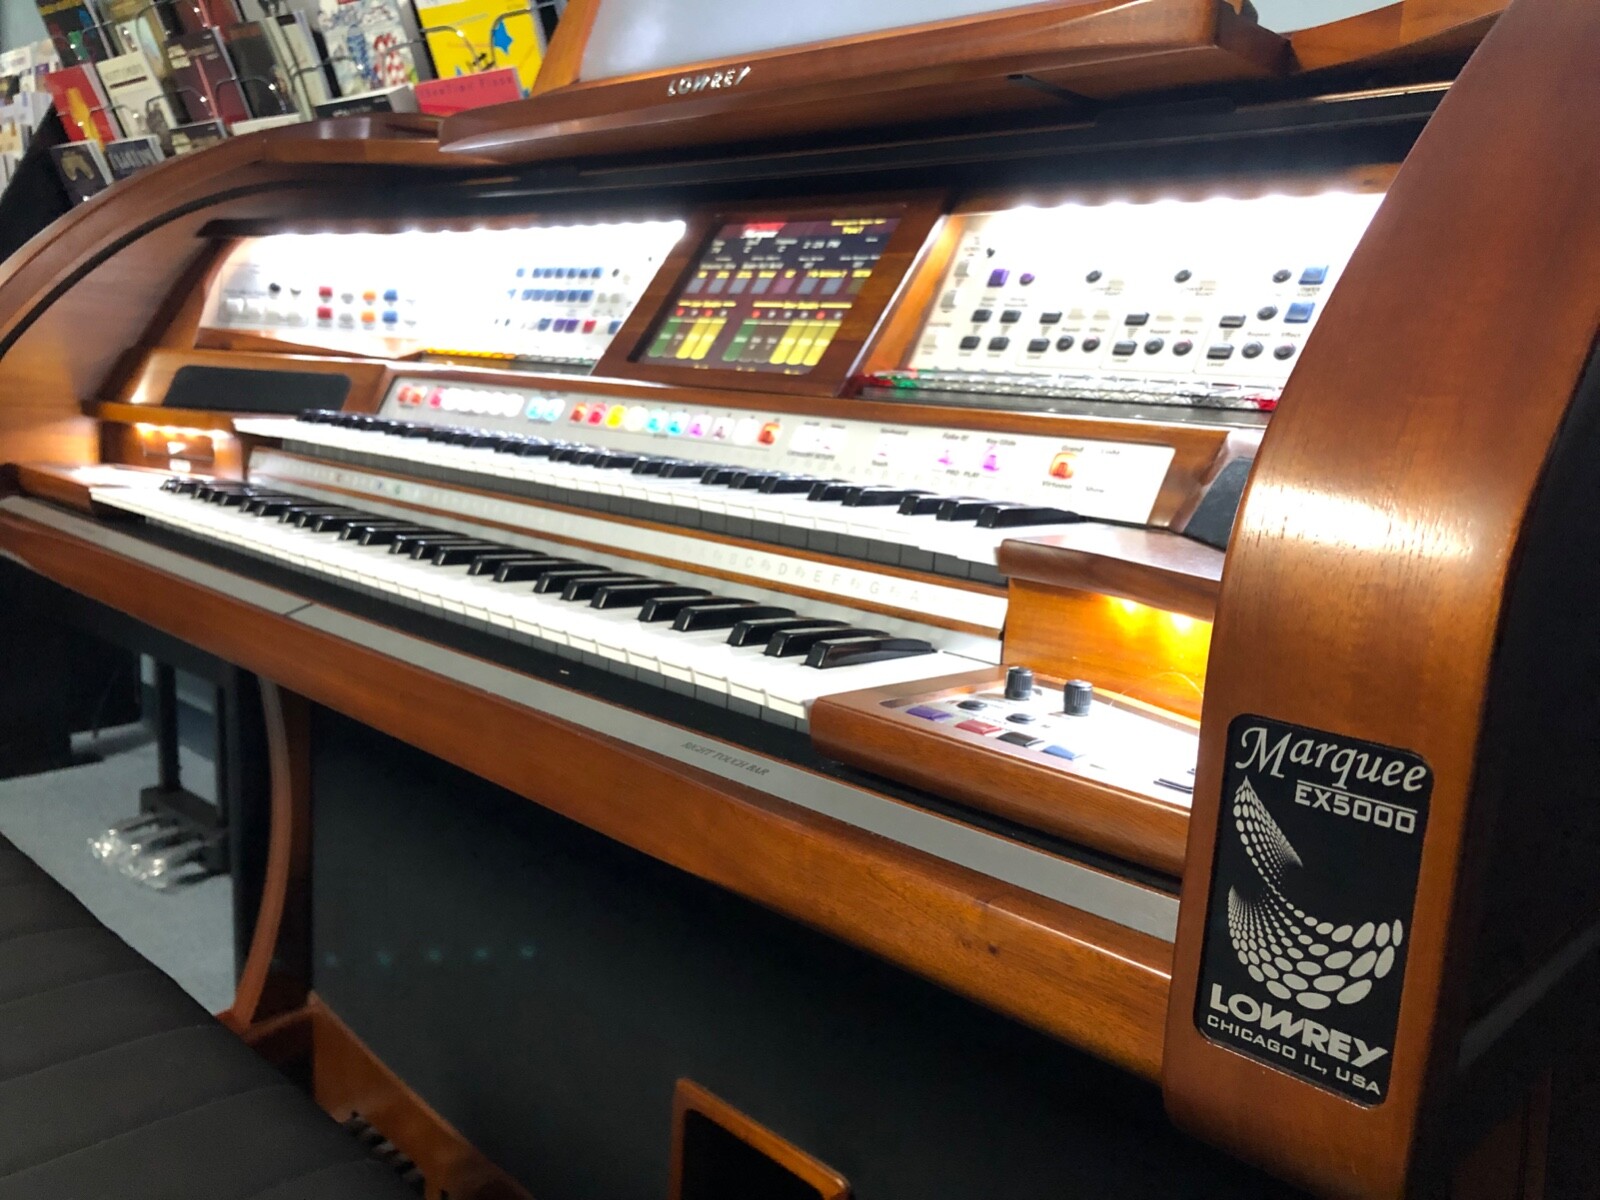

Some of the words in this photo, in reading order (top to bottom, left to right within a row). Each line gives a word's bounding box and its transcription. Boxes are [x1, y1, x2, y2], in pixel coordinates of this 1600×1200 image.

[667, 66, 751, 96] LOWREY
[680, 741, 714, 756] RIGHT
[713, 752, 748, 769] TOUCH
[746, 763, 770, 776] BAR
[1235, 726, 1428, 793] Marquee
[1294, 783, 1418, 835] EX5000
[1206, 1014, 1298, 1060] CHICAGO
[1304, 1053, 1328, 1076] IL,
[1336, 1065, 1382, 1096] USA
[1210, 982, 1390, 1070] LOWREY
